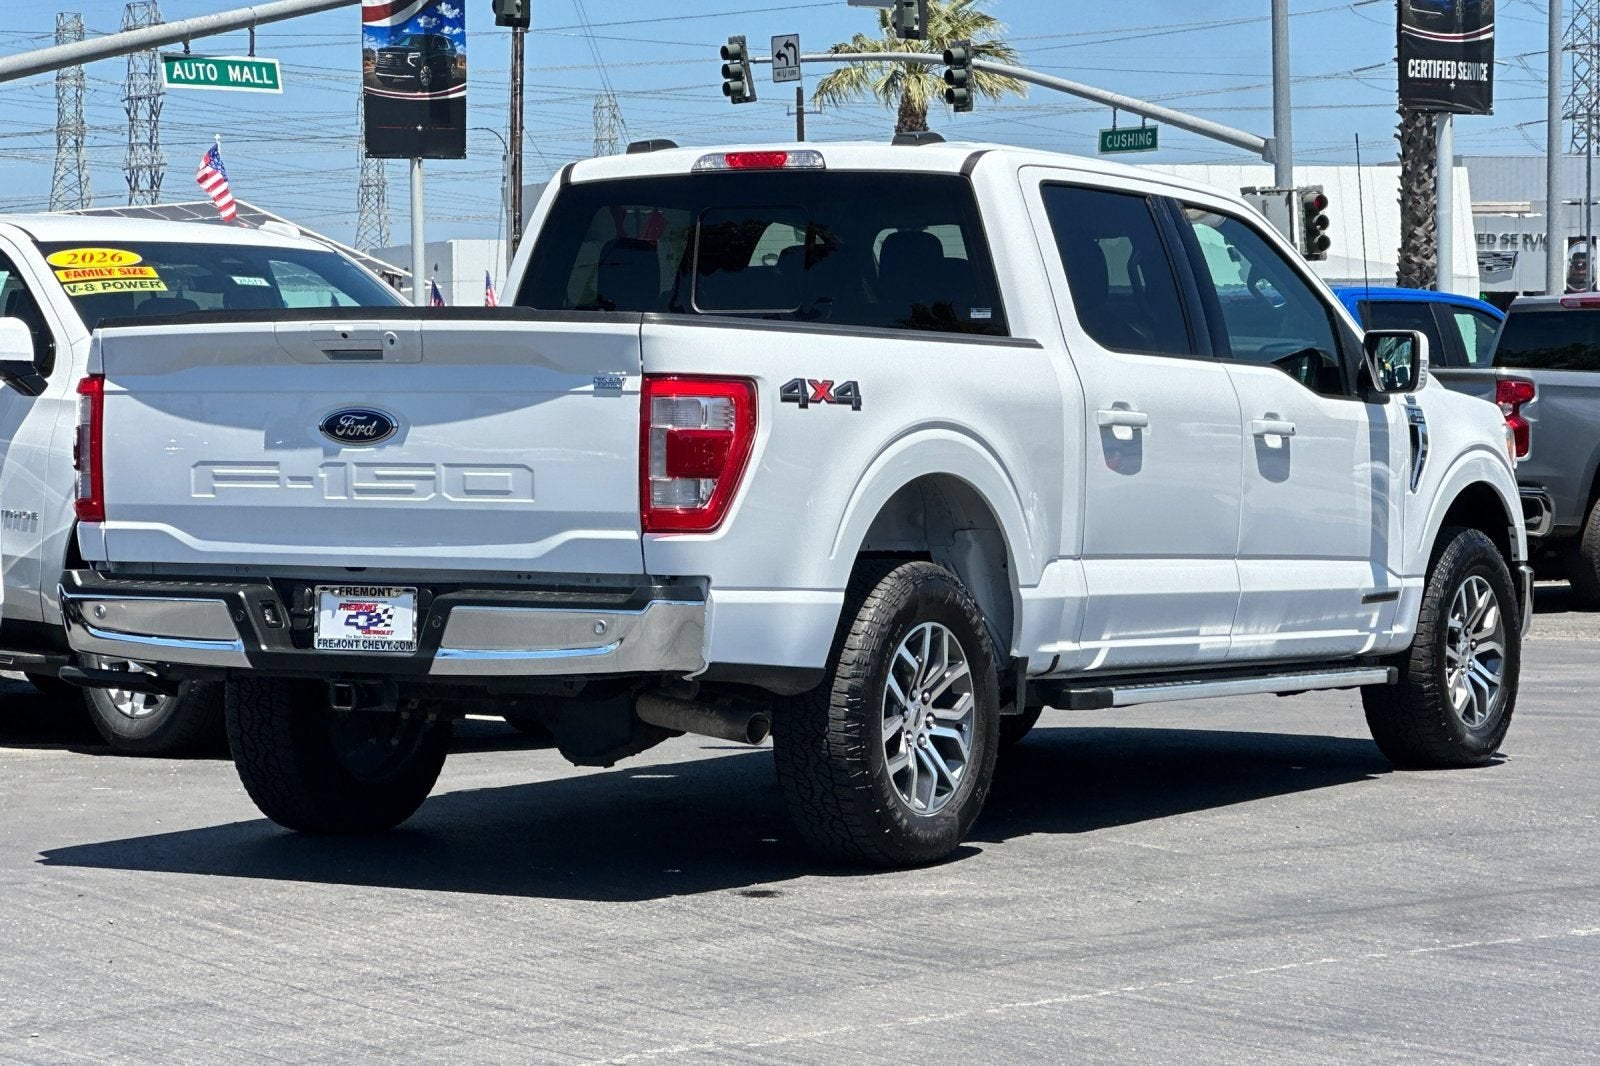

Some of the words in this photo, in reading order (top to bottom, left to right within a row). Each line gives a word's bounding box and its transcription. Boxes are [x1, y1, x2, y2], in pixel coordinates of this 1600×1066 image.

[173, 62, 218, 81] AUTO
[228, 65, 273, 84] MALL
[1408, 59, 1456, 79] CERTIFIED
[1458, 61, 1488, 81] SERVICE
[1106, 132, 1152, 148] CUSHING
[67, 252, 123, 265] 2026
[65, 267, 115, 279] FAMILY
[118, 266, 148, 276] SIZE
[66, 283, 96, 294] V-8
[101, 280, 162, 290] POWER
[336, 414, 378, 436] Ford
[191, 460, 535, 503] F-150
[339, 586, 393, 597] FREMONT
[338, 603, 379, 613] FREMONT
[317, 639, 360, 649] FREMONT
[362, 640, 414, 652] CHEVY.COM
